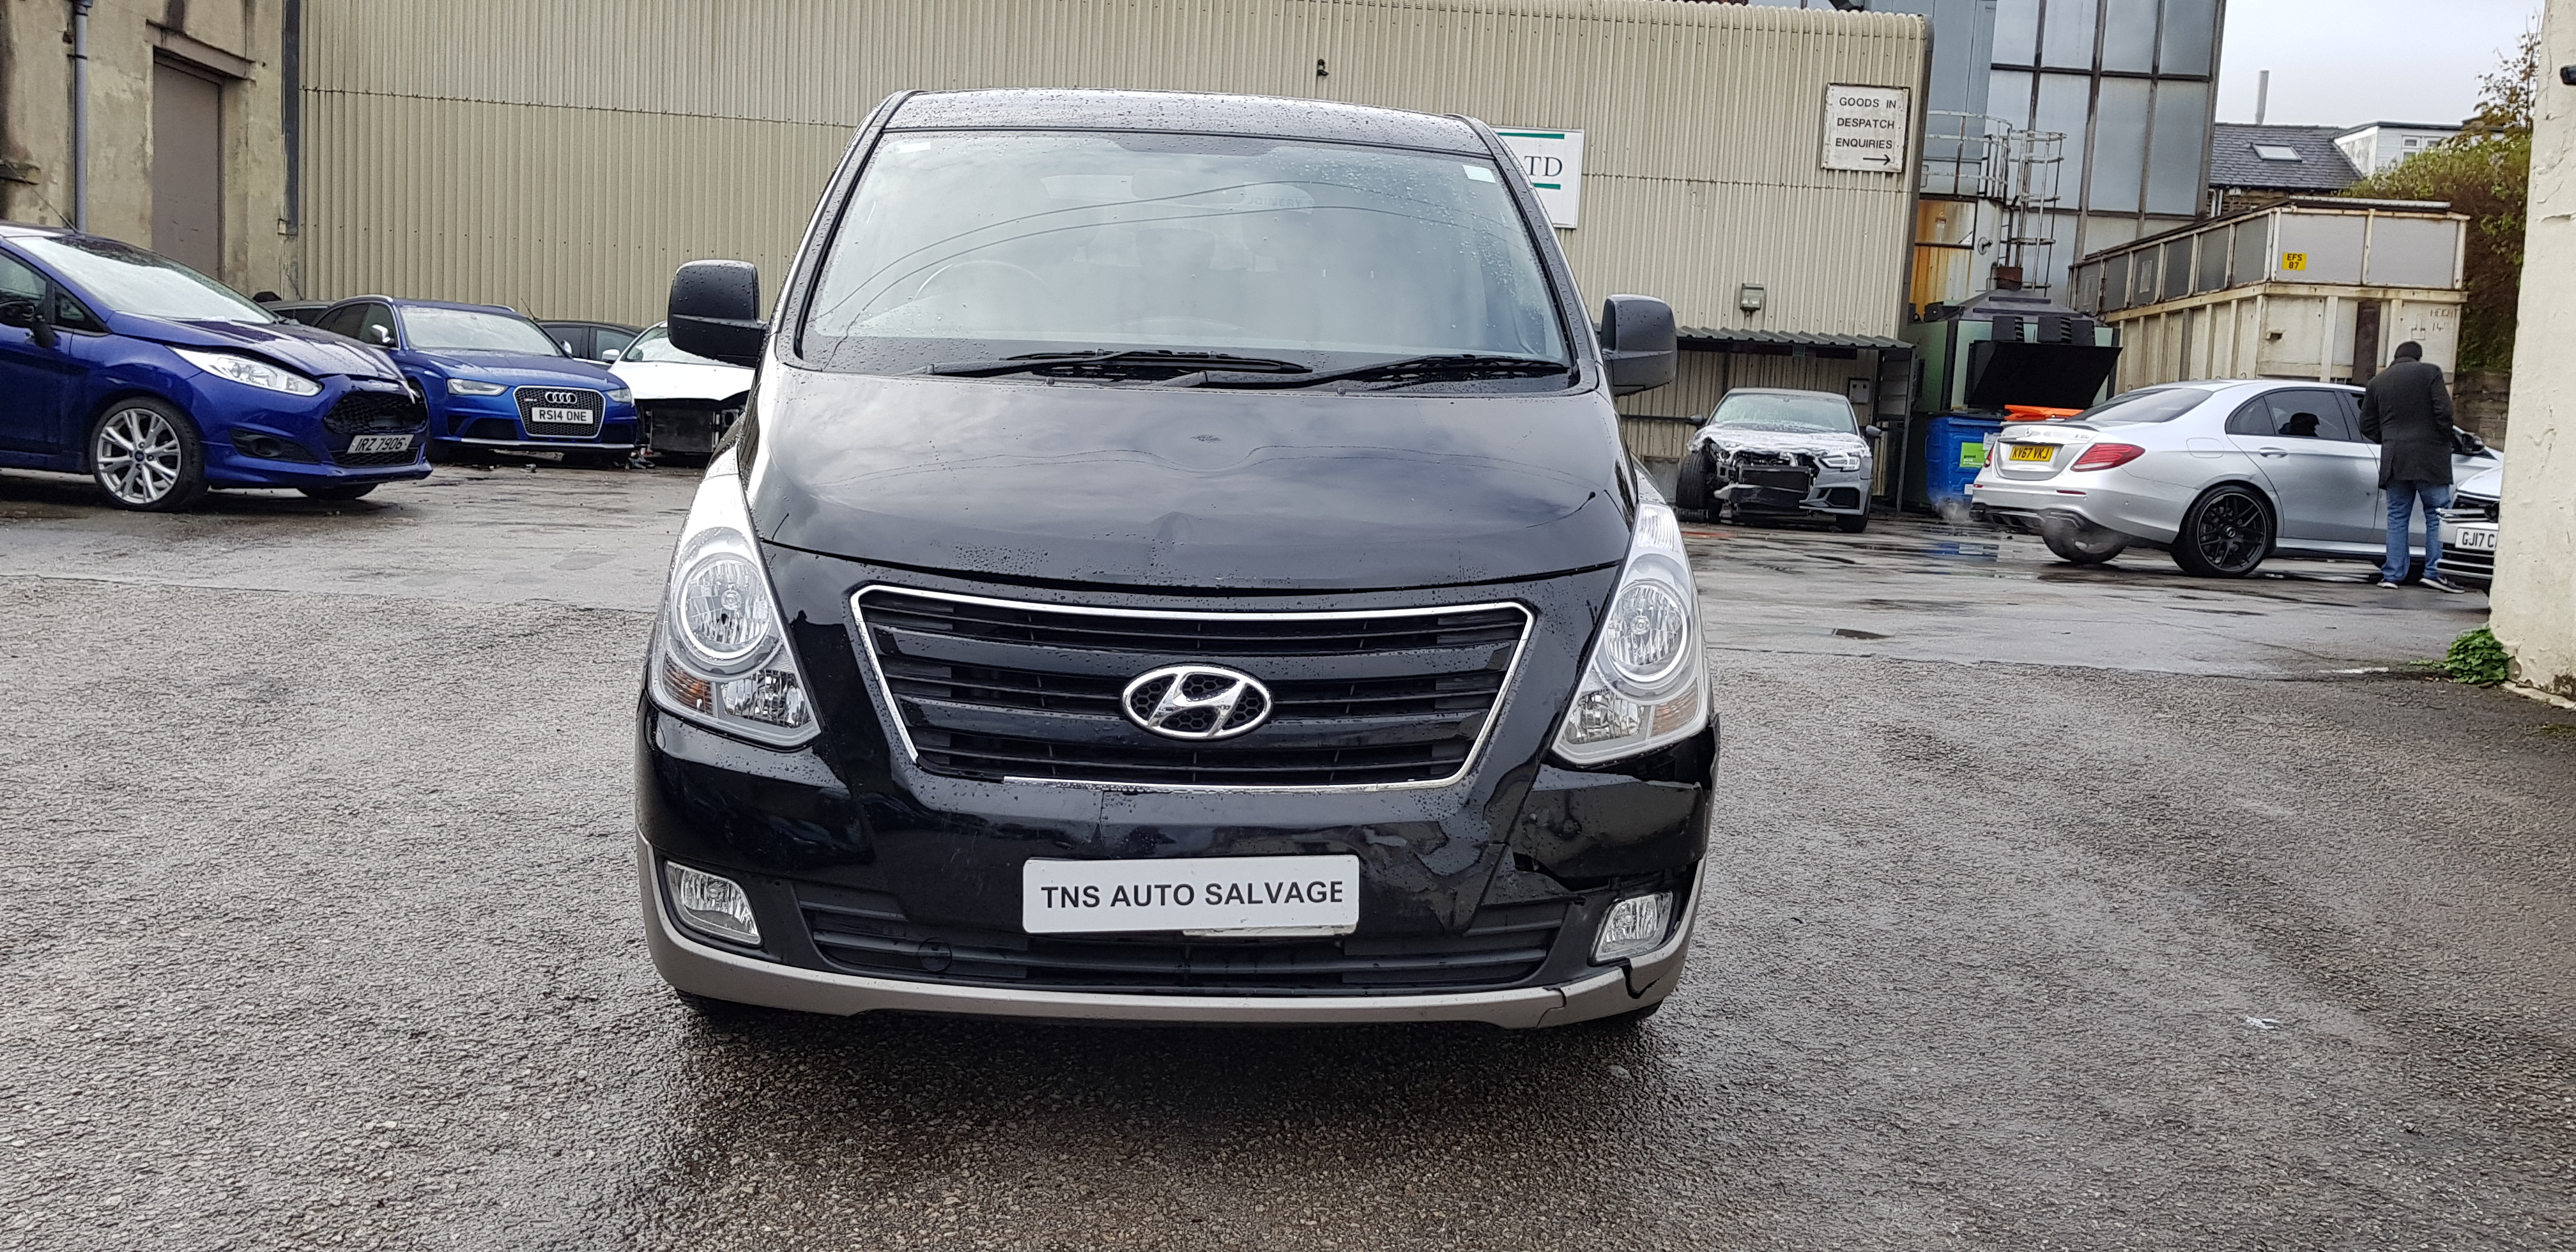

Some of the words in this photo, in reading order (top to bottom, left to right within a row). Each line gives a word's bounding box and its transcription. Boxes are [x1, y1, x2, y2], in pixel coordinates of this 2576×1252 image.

[1839, 97, 1879, 107] GOODS
[1886, 100, 1896, 109] IN
[1837, 118, 1895, 129] DESPATCH
[1836, 137, 1892, 149] ENQUIRIES
[2287, 253, 2303, 261] EFS
[2288, 261, 2299, 270] 87
[539, 409, 563, 421] RS14
[567, 411, 587, 422] ONE
[355, 438, 378, 452] IRZ
[375, 437, 406, 451] 7906
[2012, 447, 2033, 458] KV67
[2034, 447, 2050, 459] VKJ
[2462, 531, 2485, 547] GJ17
[1041, 885, 1101, 908] TNS
[1110, 883, 1195, 907] AUTO
[1204, 880, 1343, 906] SALVAGE
